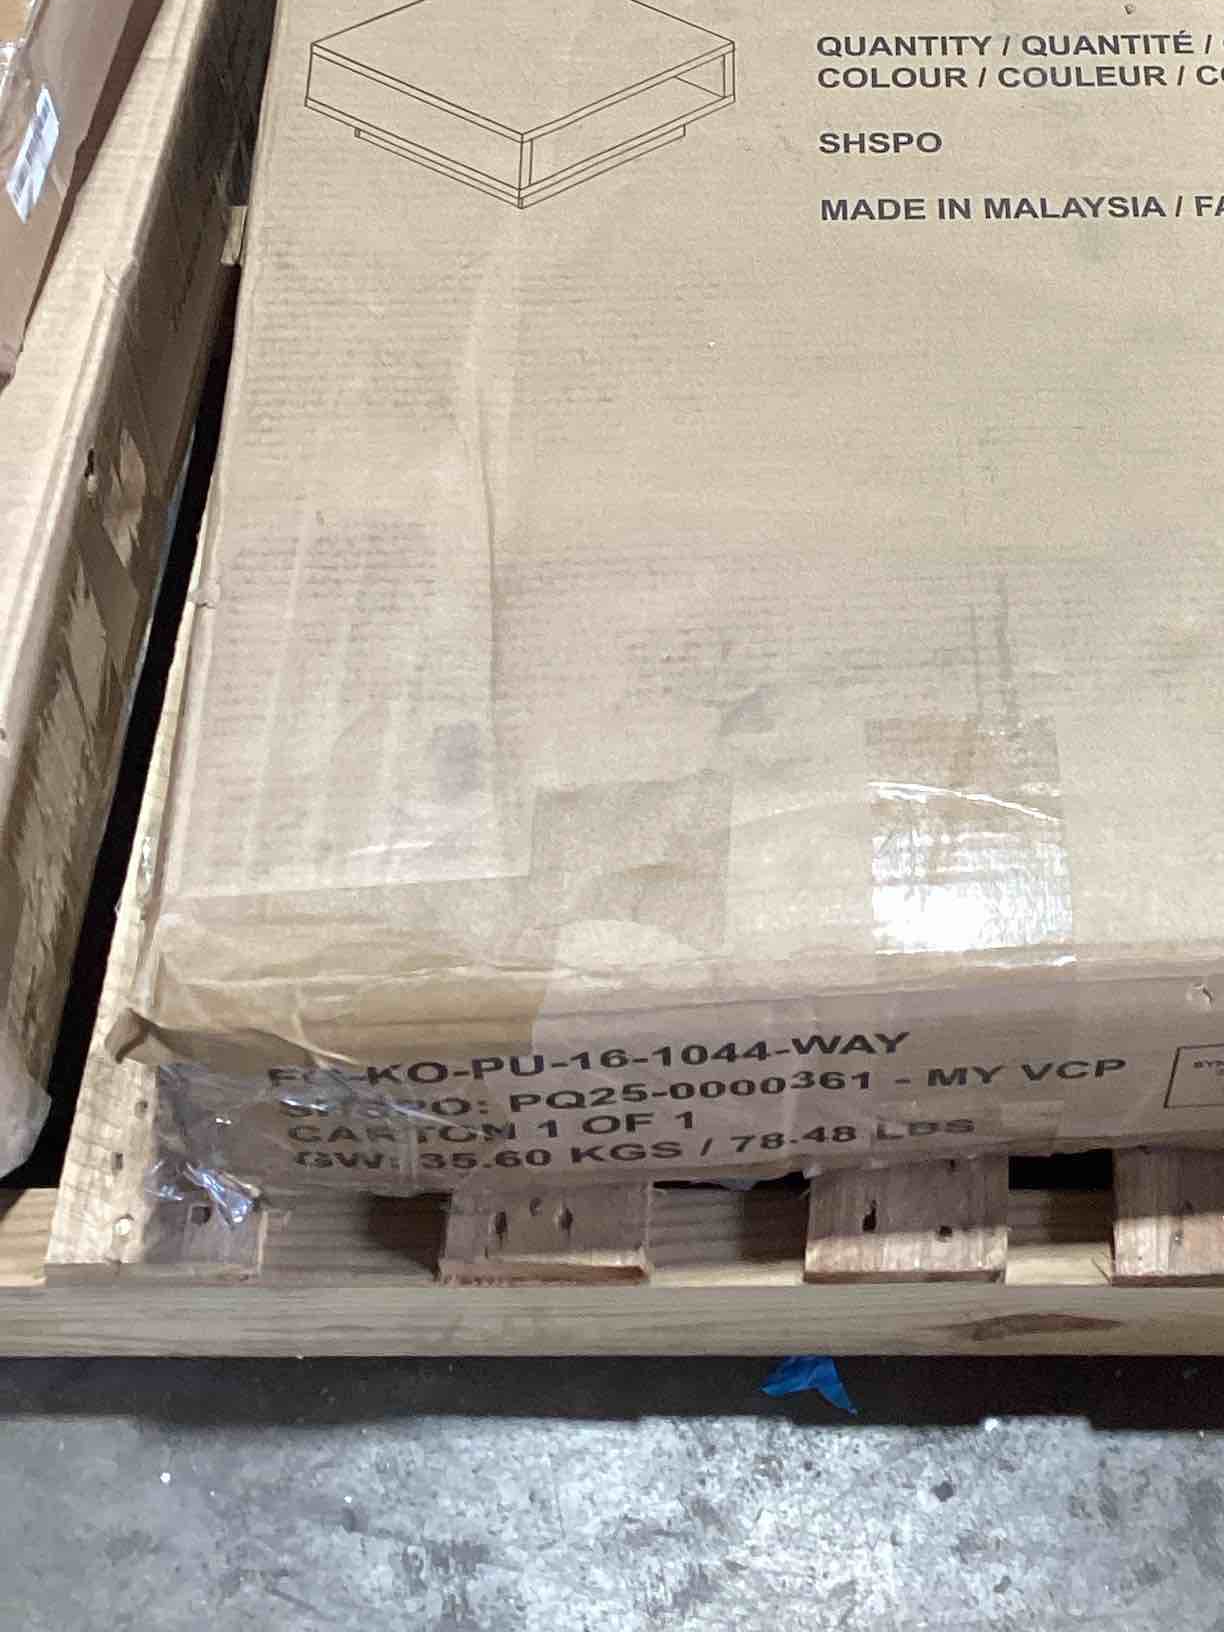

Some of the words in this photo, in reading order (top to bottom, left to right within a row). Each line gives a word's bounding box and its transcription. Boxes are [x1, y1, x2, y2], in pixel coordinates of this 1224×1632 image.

[816, 35, 993, 58] QUANTITY
[1021, 29, 1195, 57] QUANTITÉ
[817, 67, 968, 89] COLOUR
[997, 65, 1168, 89] COULEUR
[819, 132, 943, 154] SHSPO
[821, 198, 926, 221] MADE
[937, 197, 972, 220] IN
[983, 196, 1167, 220] MALAYSIA
[509, 1071, 871, 1110] PQ25-0000361
[928, 1067, 1005, 1087] MY
[1021, 1058, 1127, 1083] VCP
[537, 1120, 558, 1138] 1
[582, 1113, 655, 1135] OF
[679, 1112, 694, 1129] 1
[570, 1141, 684, 1164] KGS
